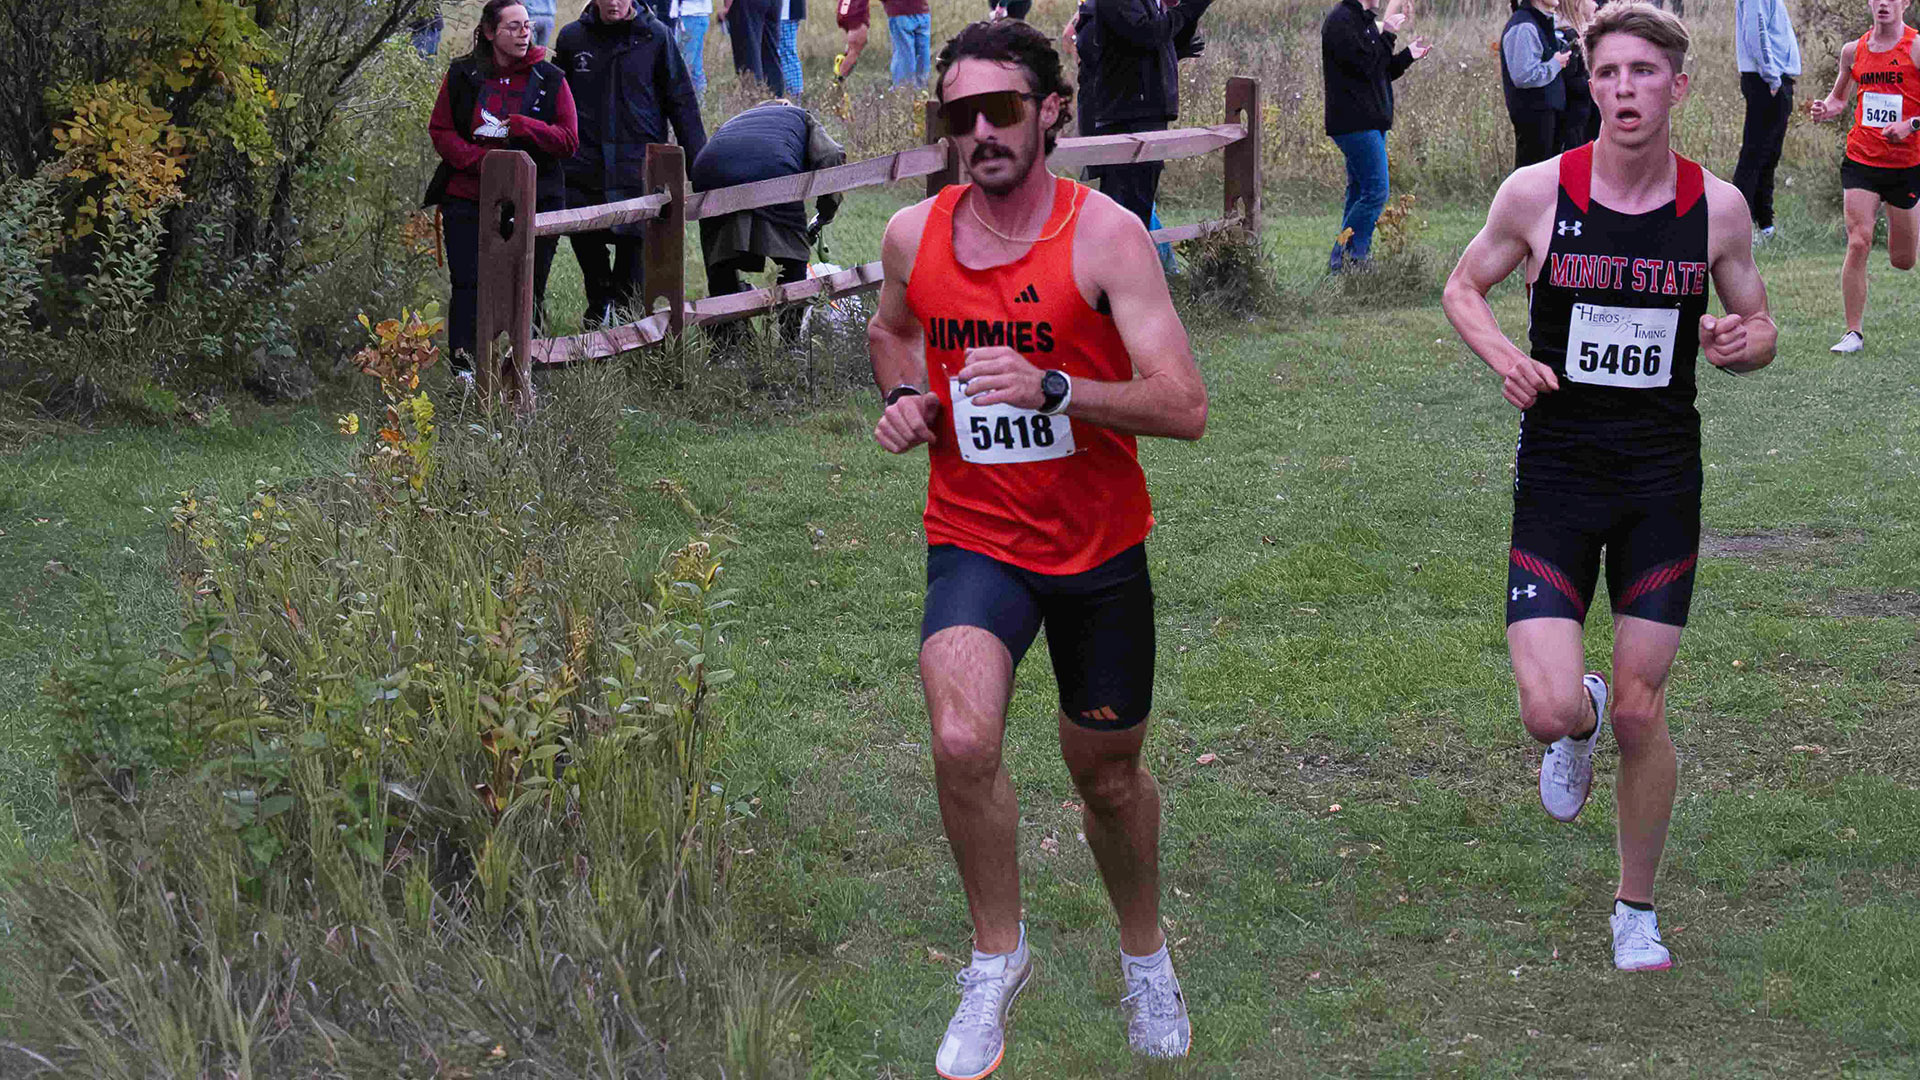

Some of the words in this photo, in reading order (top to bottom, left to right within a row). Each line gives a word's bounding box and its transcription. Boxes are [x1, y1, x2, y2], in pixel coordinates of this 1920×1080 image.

[1866, 108, 1897, 122] 5426
[1550, 253, 1627, 290] MINOT
[1631, 258, 1707, 296] STATE
[928, 317, 1055, 352] JIMMIES
[1579, 341, 1662, 377] 5466
[970, 414, 1055, 450] 5418
